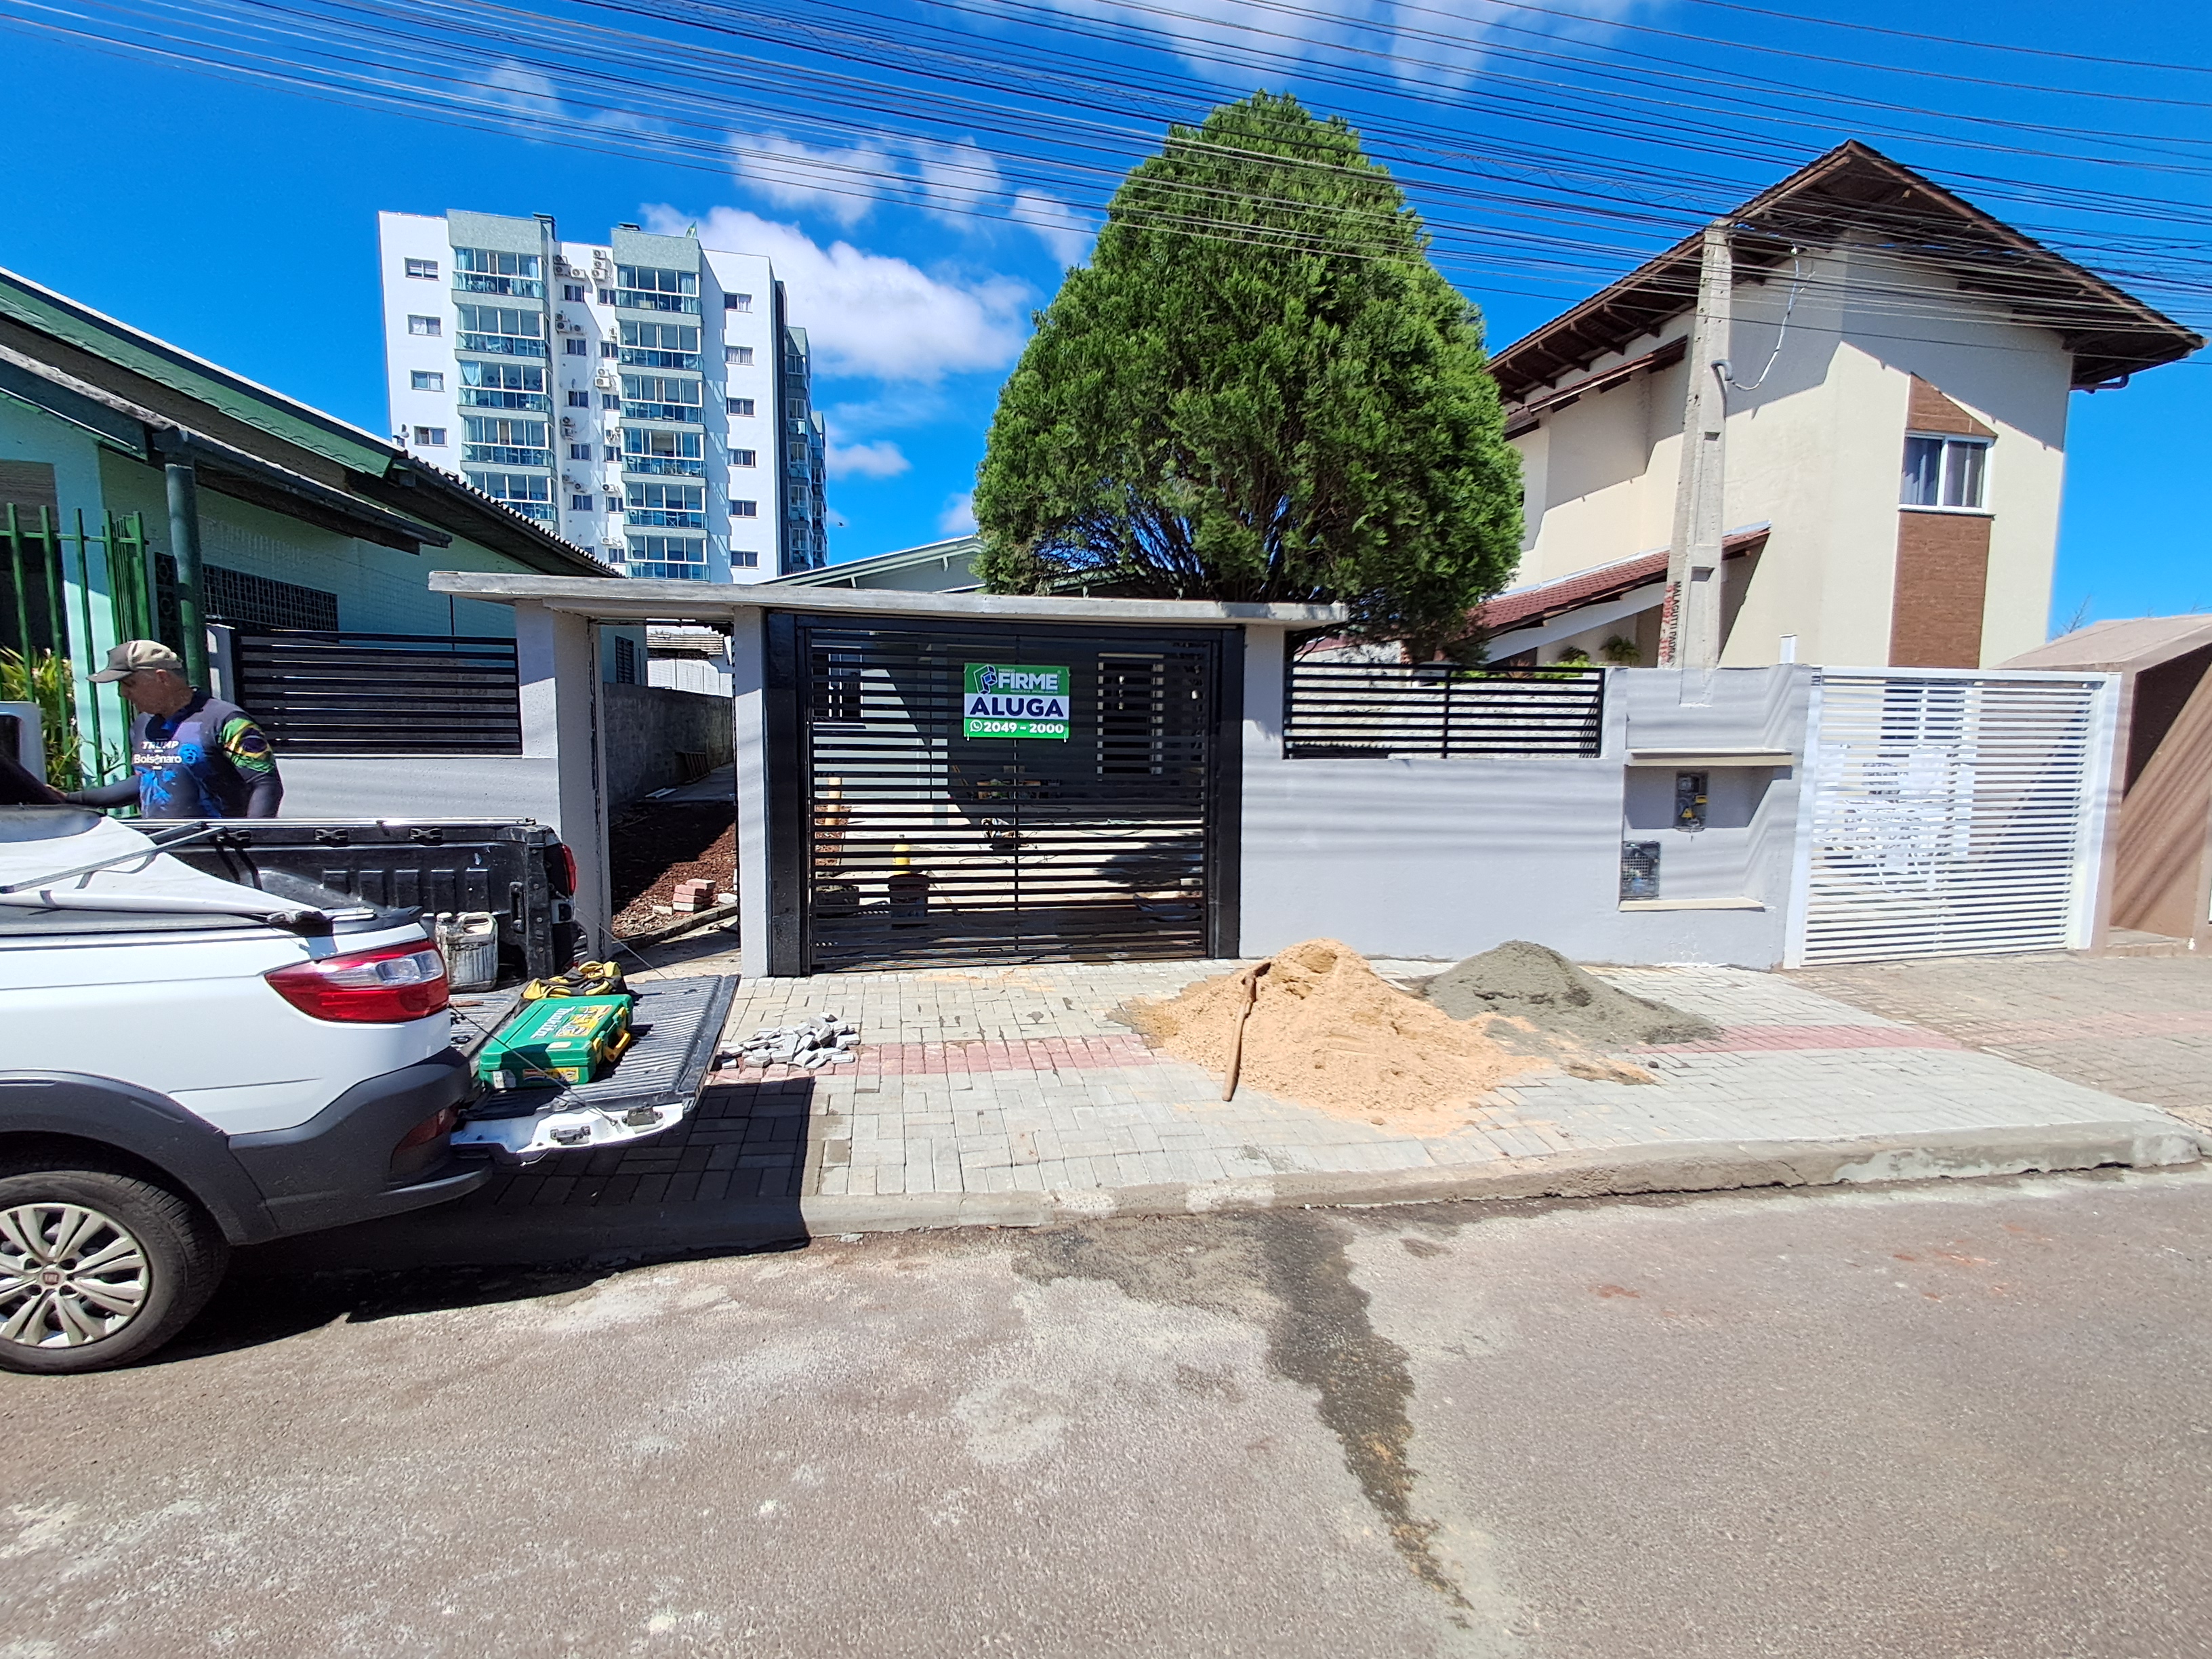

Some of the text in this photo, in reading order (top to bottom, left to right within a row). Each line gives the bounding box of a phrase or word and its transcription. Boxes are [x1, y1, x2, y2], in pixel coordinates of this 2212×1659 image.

[1669, 581, 1682, 630] MALAGUTTI
[998, 672, 1058, 690] FIRME
[969, 697, 1064, 717] ALUGA
[984, 722, 1017, 733] 2049
[1029, 723, 1064, 733] 2000
[142, 741, 180, 750] TRUMP
[134, 754, 182, 764] Bolsonaro
